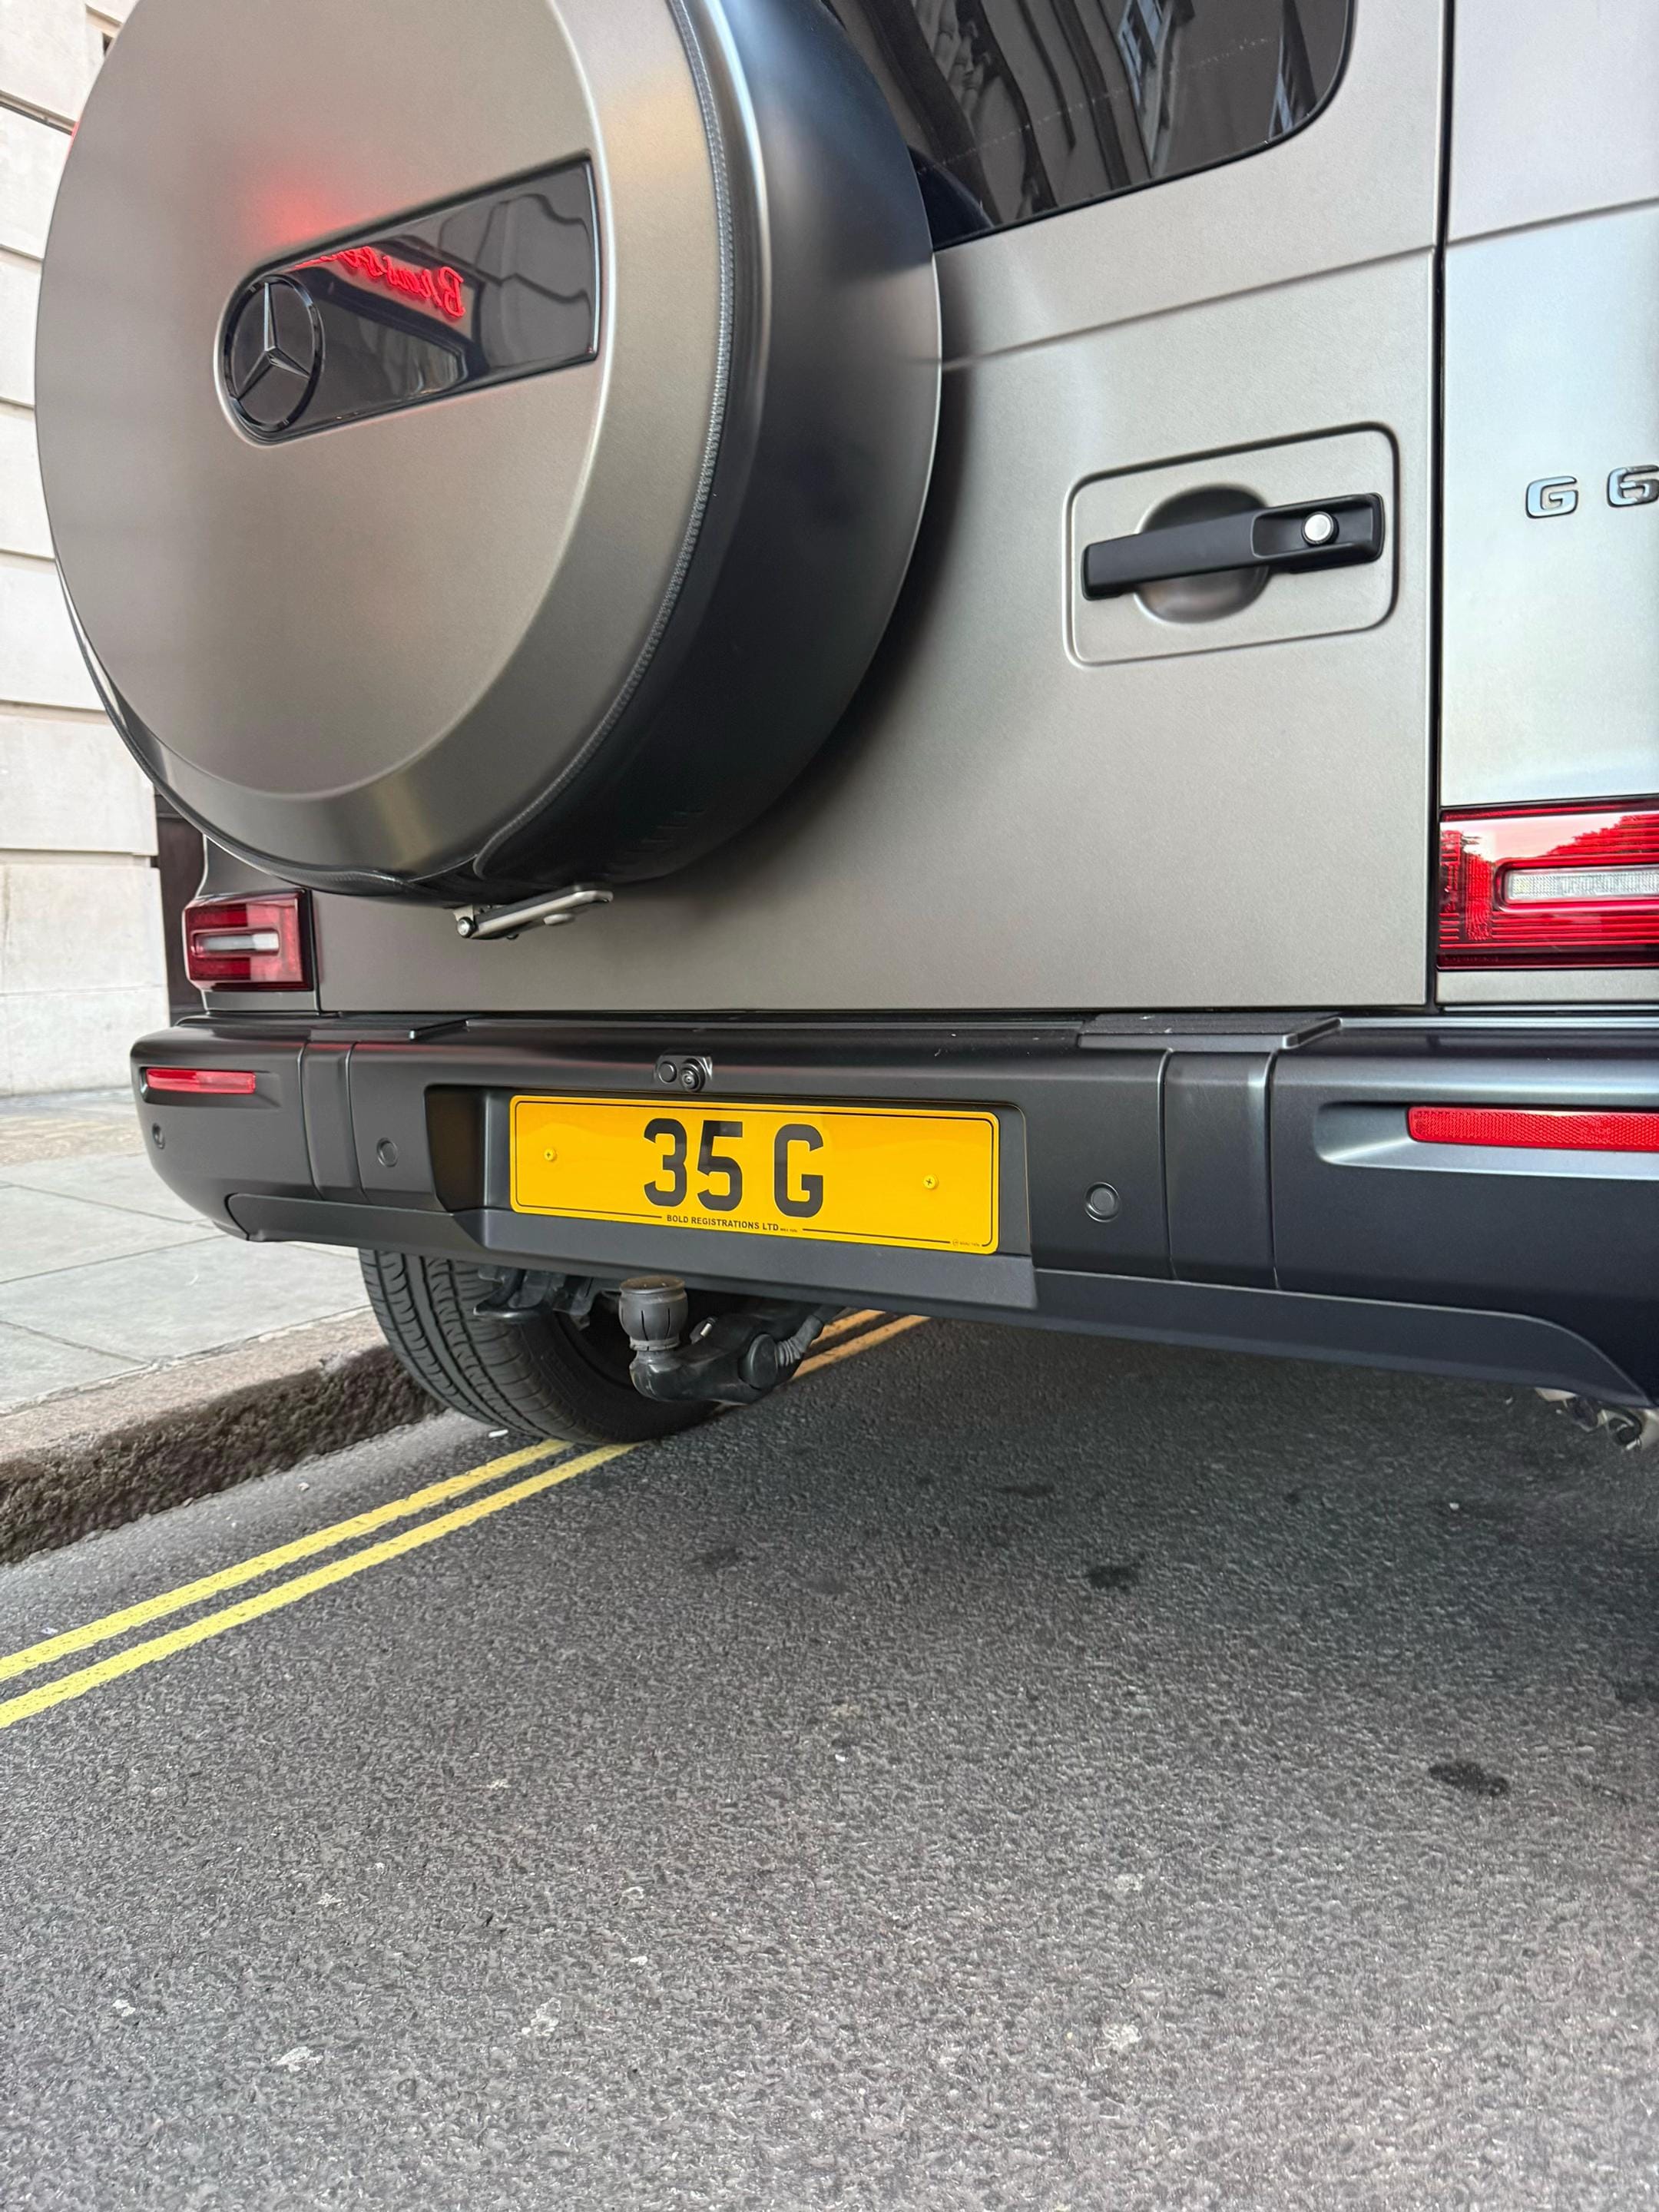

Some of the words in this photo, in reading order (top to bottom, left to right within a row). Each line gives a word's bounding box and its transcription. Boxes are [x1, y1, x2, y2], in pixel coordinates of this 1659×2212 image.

[1525, 475, 1578, 519] G
[1607, 464, 1659, 508] 6
[644, 1118, 743, 1211] 35
[774, 1124, 823, 1217] G
[667, 1214, 689, 1224] BOLD
[691, 1217, 760, 1230] REGISTRATIONS
[763, 1223, 779, 1231] LTD
